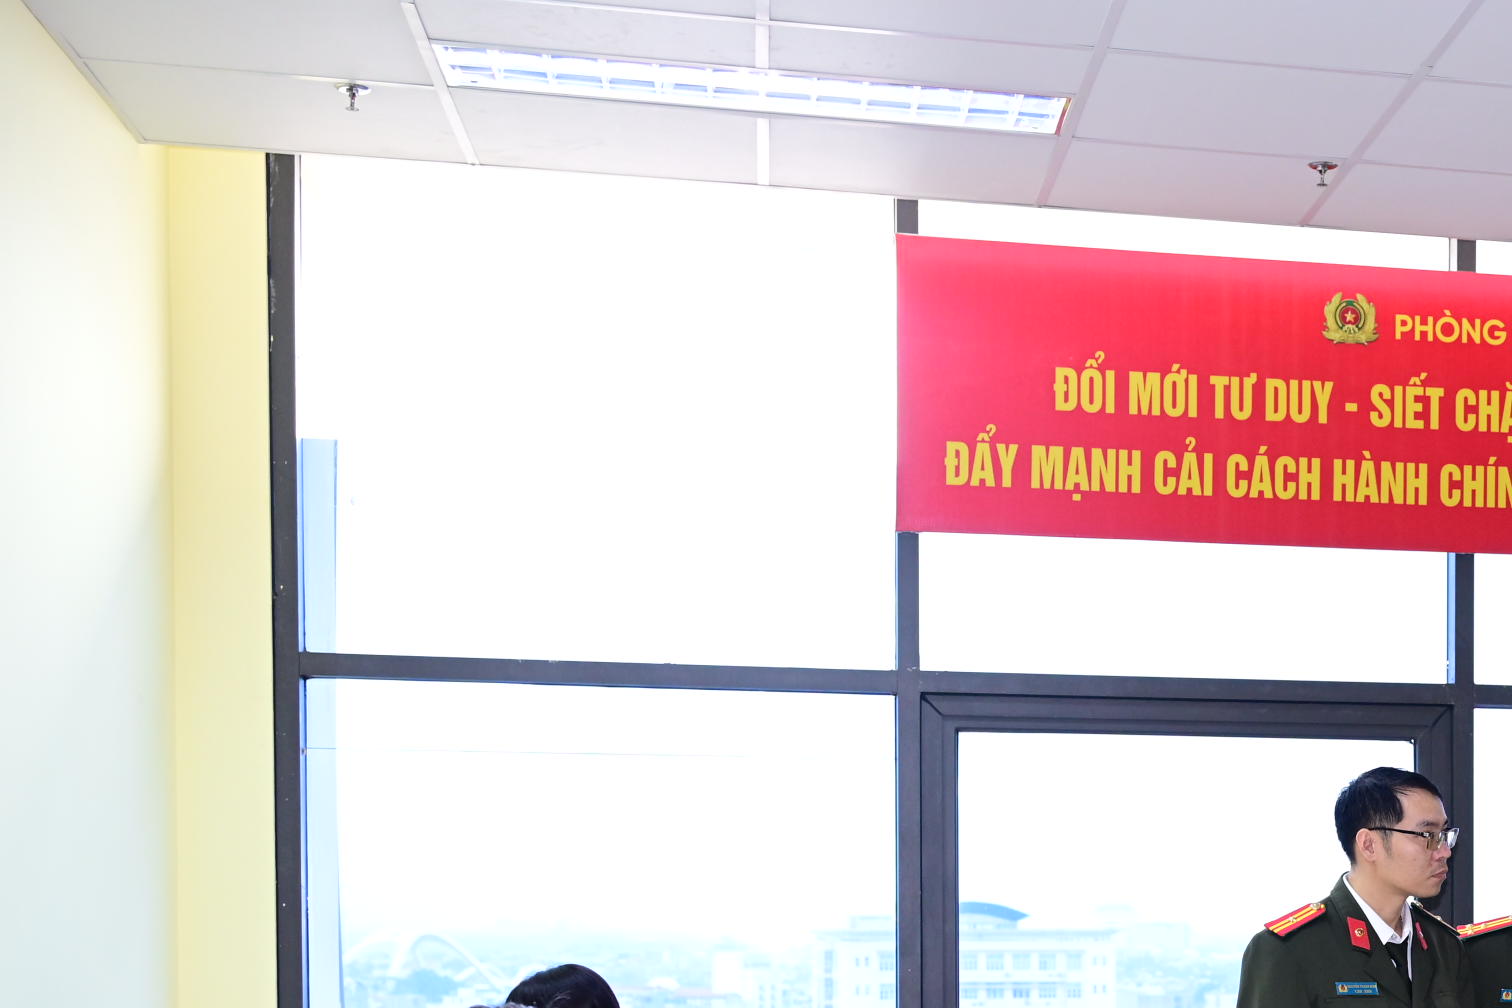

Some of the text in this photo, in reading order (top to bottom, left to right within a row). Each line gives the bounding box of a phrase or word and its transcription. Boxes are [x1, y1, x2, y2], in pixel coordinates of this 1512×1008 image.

[1395, 309, 1507, 346] PHÒNG
[1053, 350, 1116, 415] ĐỔI
[1128, 363, 1198, 418] MỚI
[1209, 372, 1258, 421] TƯ
[1264, 377, 1334, 425] DUY
[1369, 372, 1445, 430] SIẾT
[944, 423, 1020, 489] ĐẨY
[1030, 444, 1142, 502] MẠNH
[1154, 436, 1214, 497] CẢI
[1226, 445, 1321, 501] CÁCH
[1332, 450, 1428, 506] HÀNH
